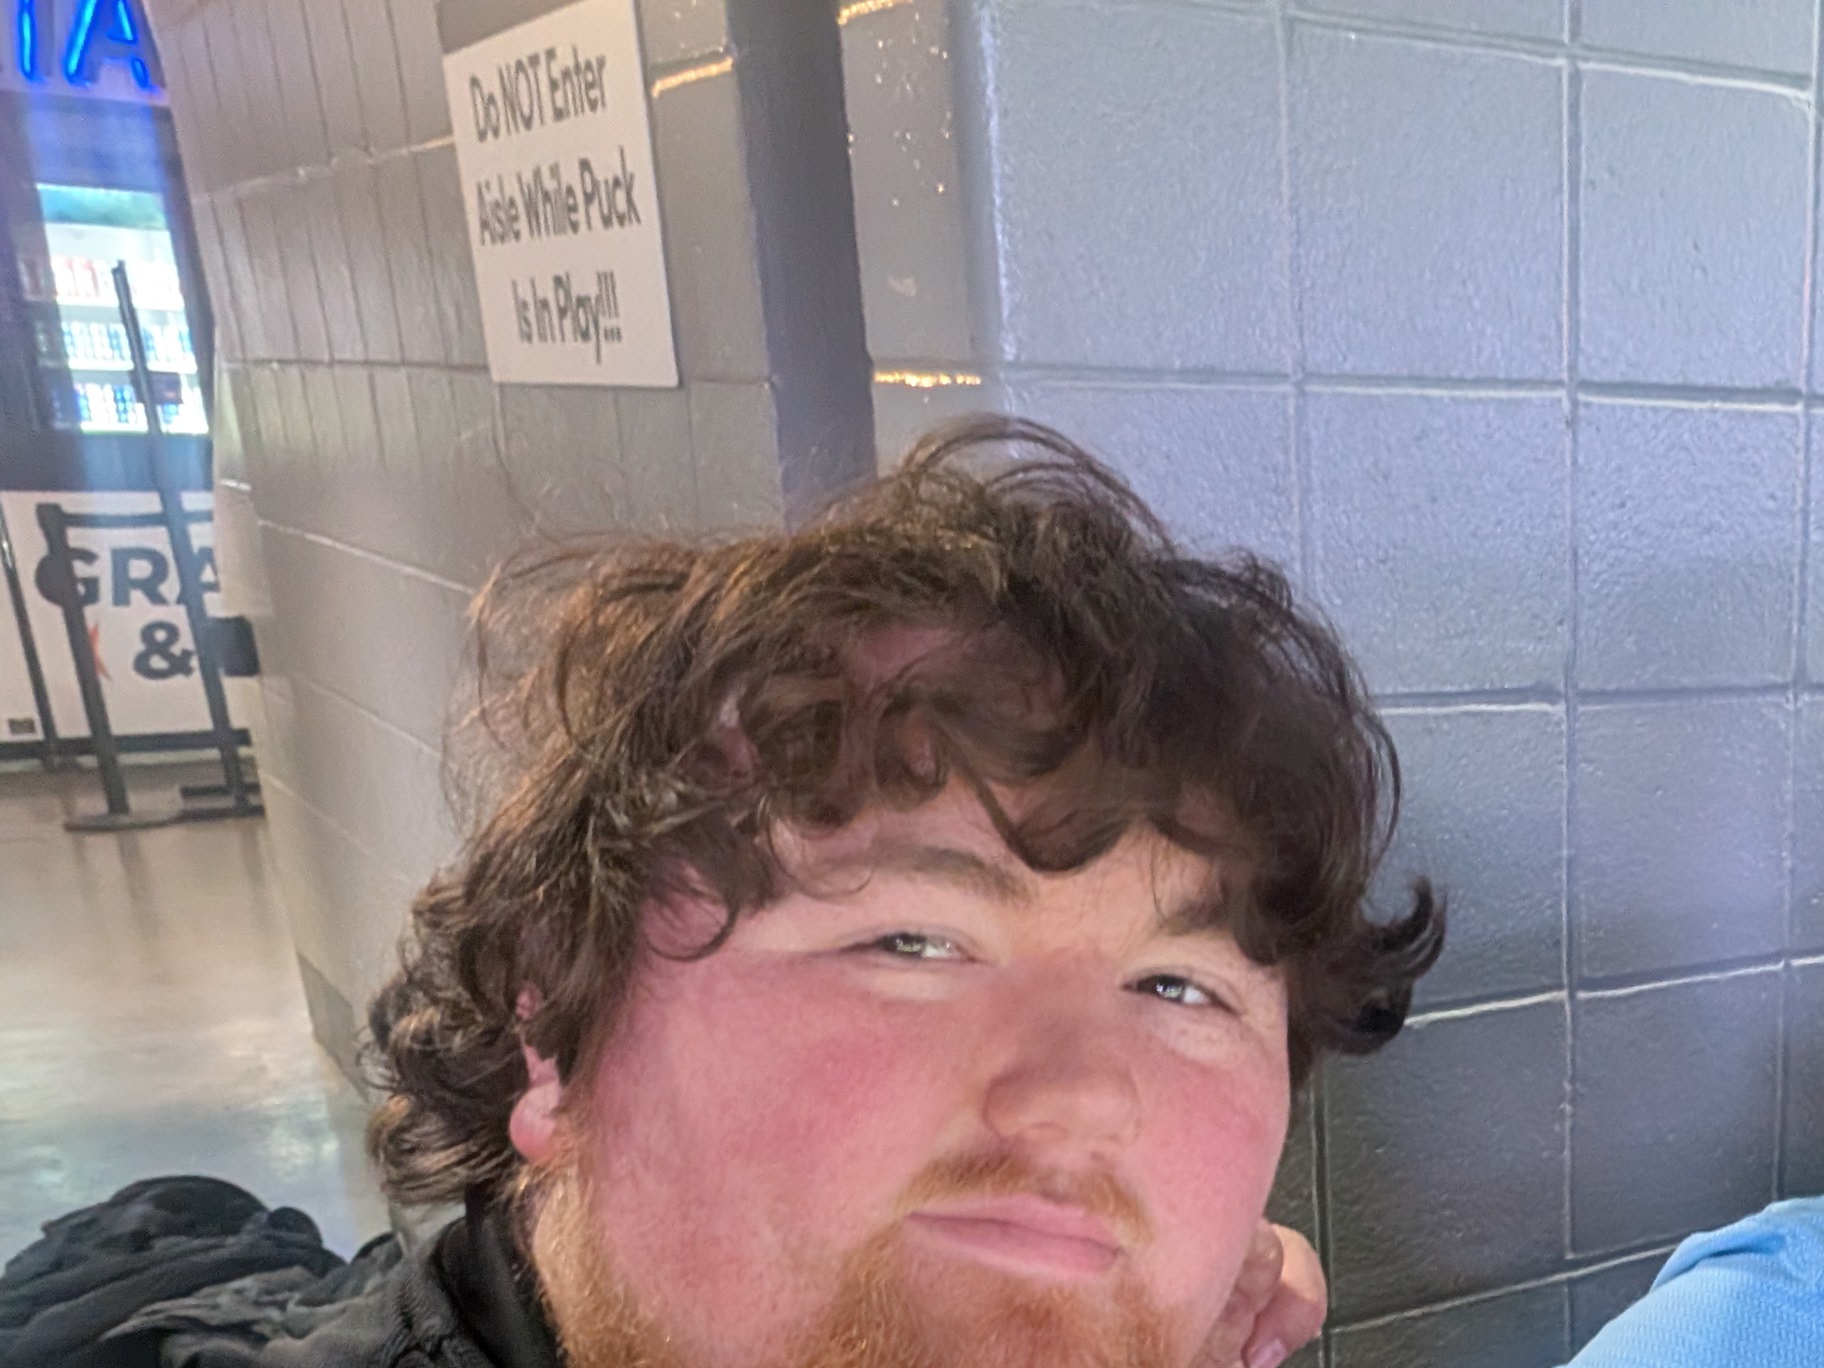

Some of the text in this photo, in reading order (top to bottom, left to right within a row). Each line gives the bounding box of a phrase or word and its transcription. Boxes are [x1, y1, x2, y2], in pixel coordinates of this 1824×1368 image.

[469, 44, 607, 143] Do NOT Enter
[476, 144, 641, 246] Aisle While Puck
[511, 269, 623, 365] Is In Play!!!
[133, 619, 198, 680] &
